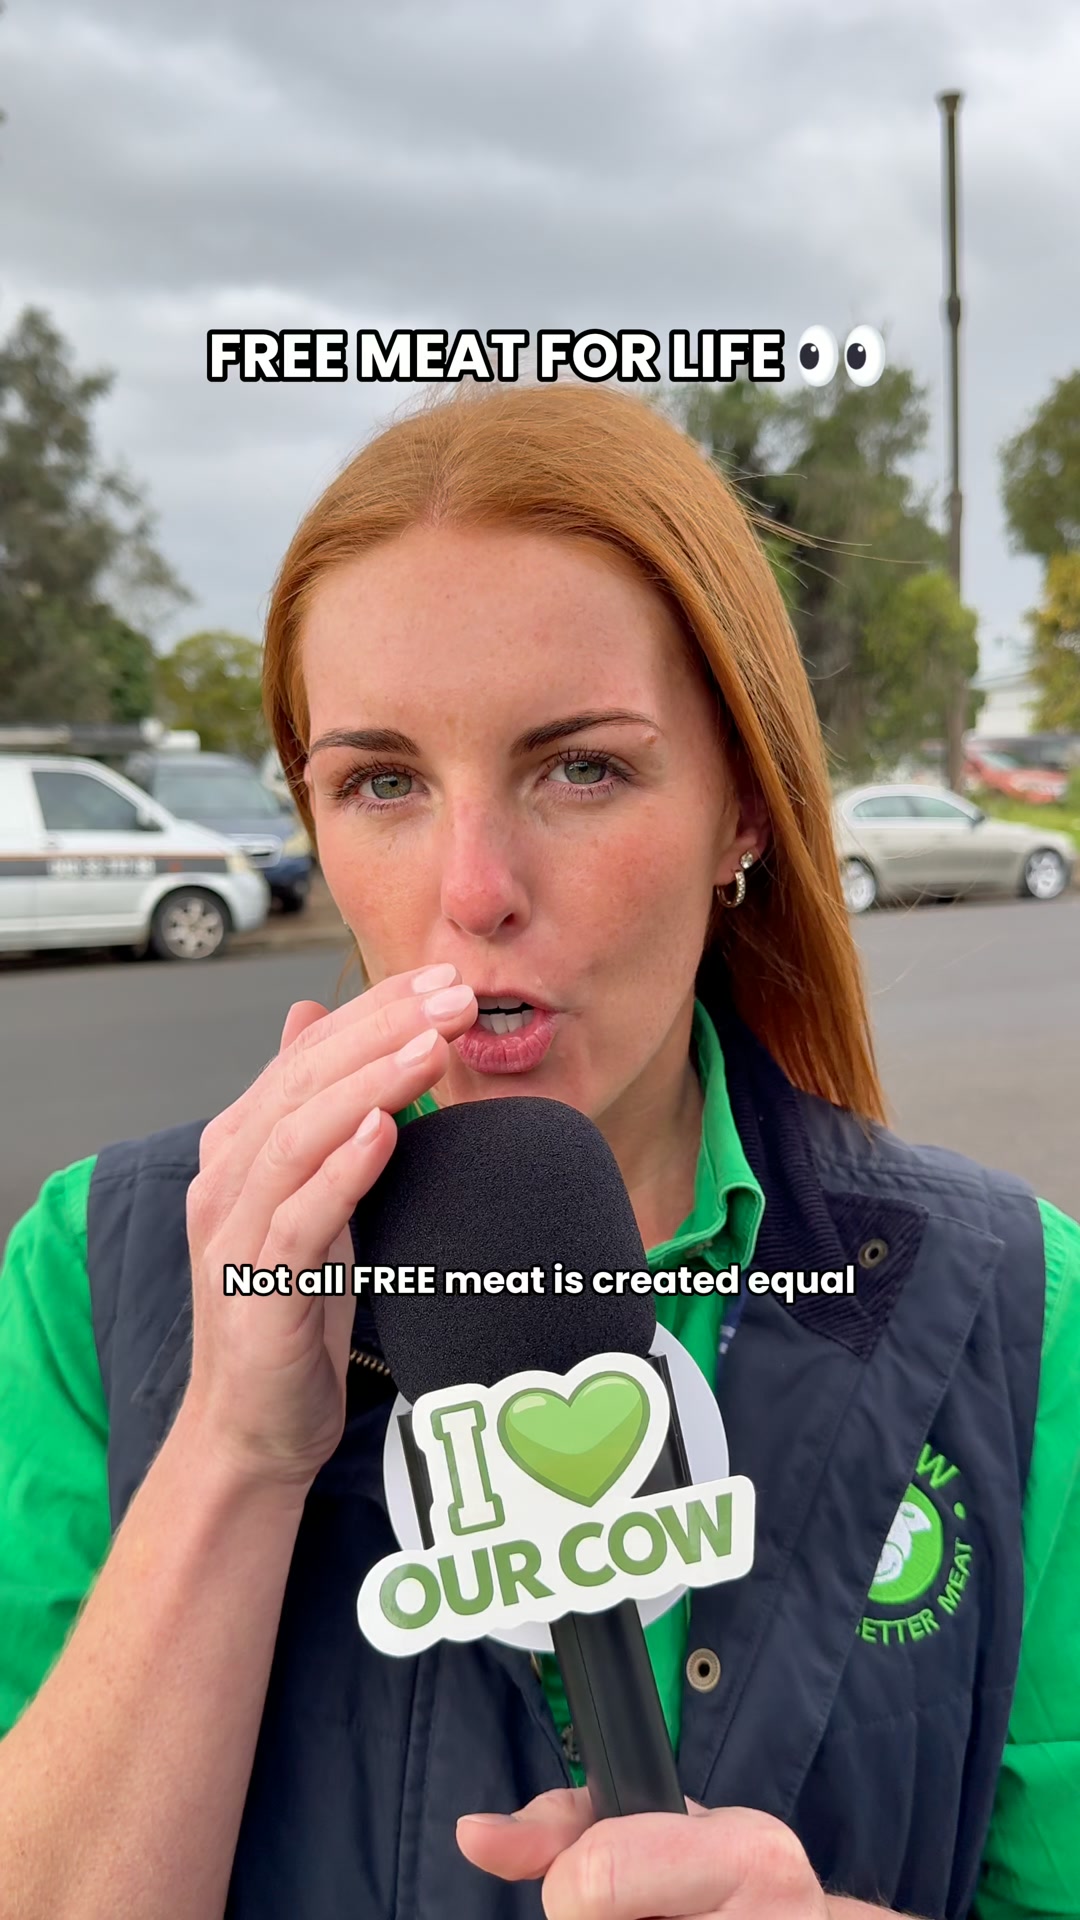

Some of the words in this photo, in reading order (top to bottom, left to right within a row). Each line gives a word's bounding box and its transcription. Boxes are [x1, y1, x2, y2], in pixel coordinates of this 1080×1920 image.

[430, 1400, 506, 1536] I
[379, 1539, 556, 1630] OUR
[558, 1492, 733, 1588] COW
[855, 1608, 940, 1646] ETTER
[937, 1537, 973, 1616] MEAT
